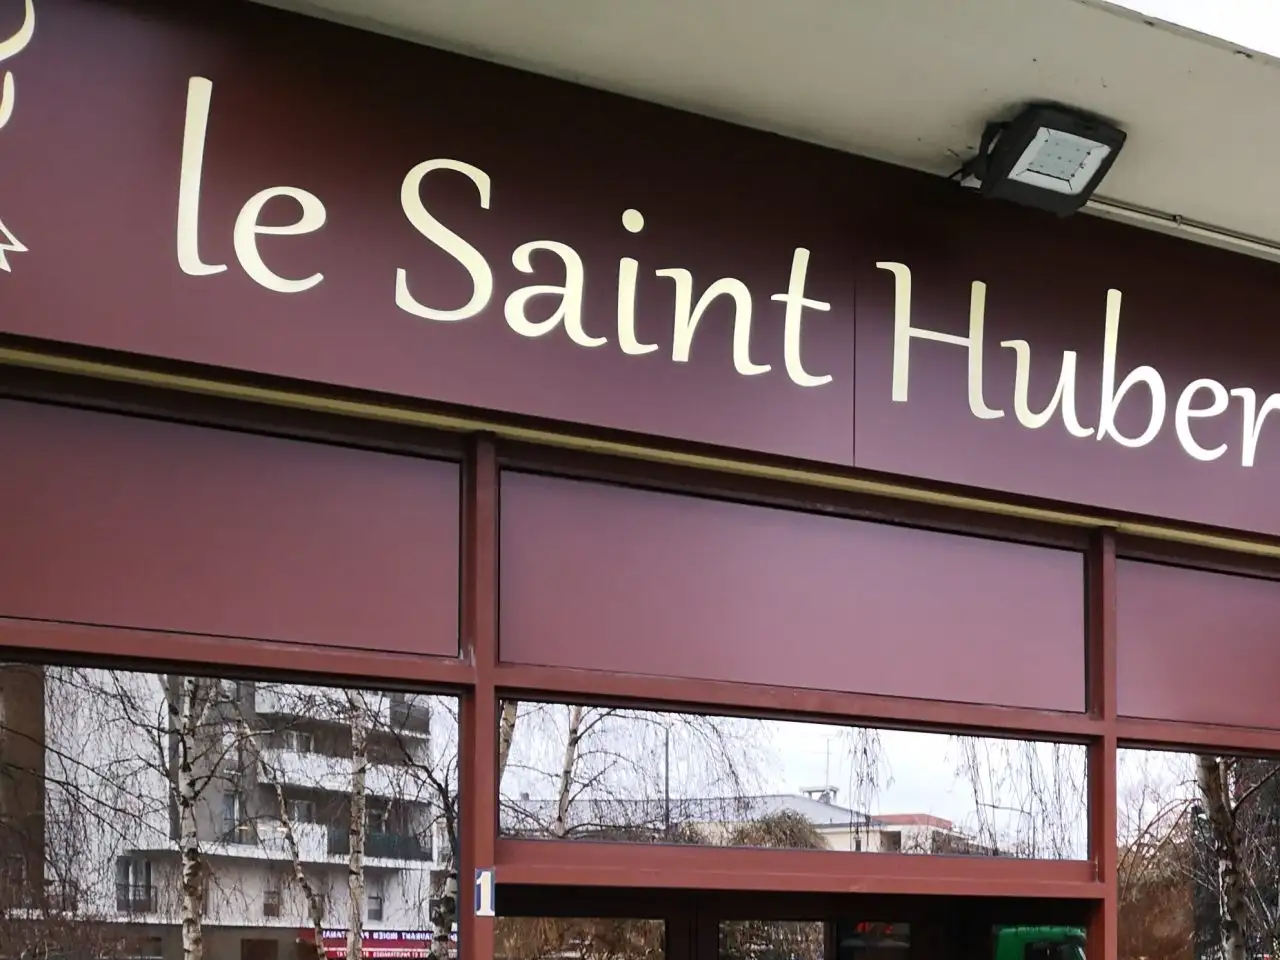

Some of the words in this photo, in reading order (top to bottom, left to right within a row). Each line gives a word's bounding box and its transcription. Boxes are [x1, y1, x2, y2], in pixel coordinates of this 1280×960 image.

[176, 76, 327, 294] le
[395, 158, 833, 388] Saint
[476, 870, 496, 916] 1
